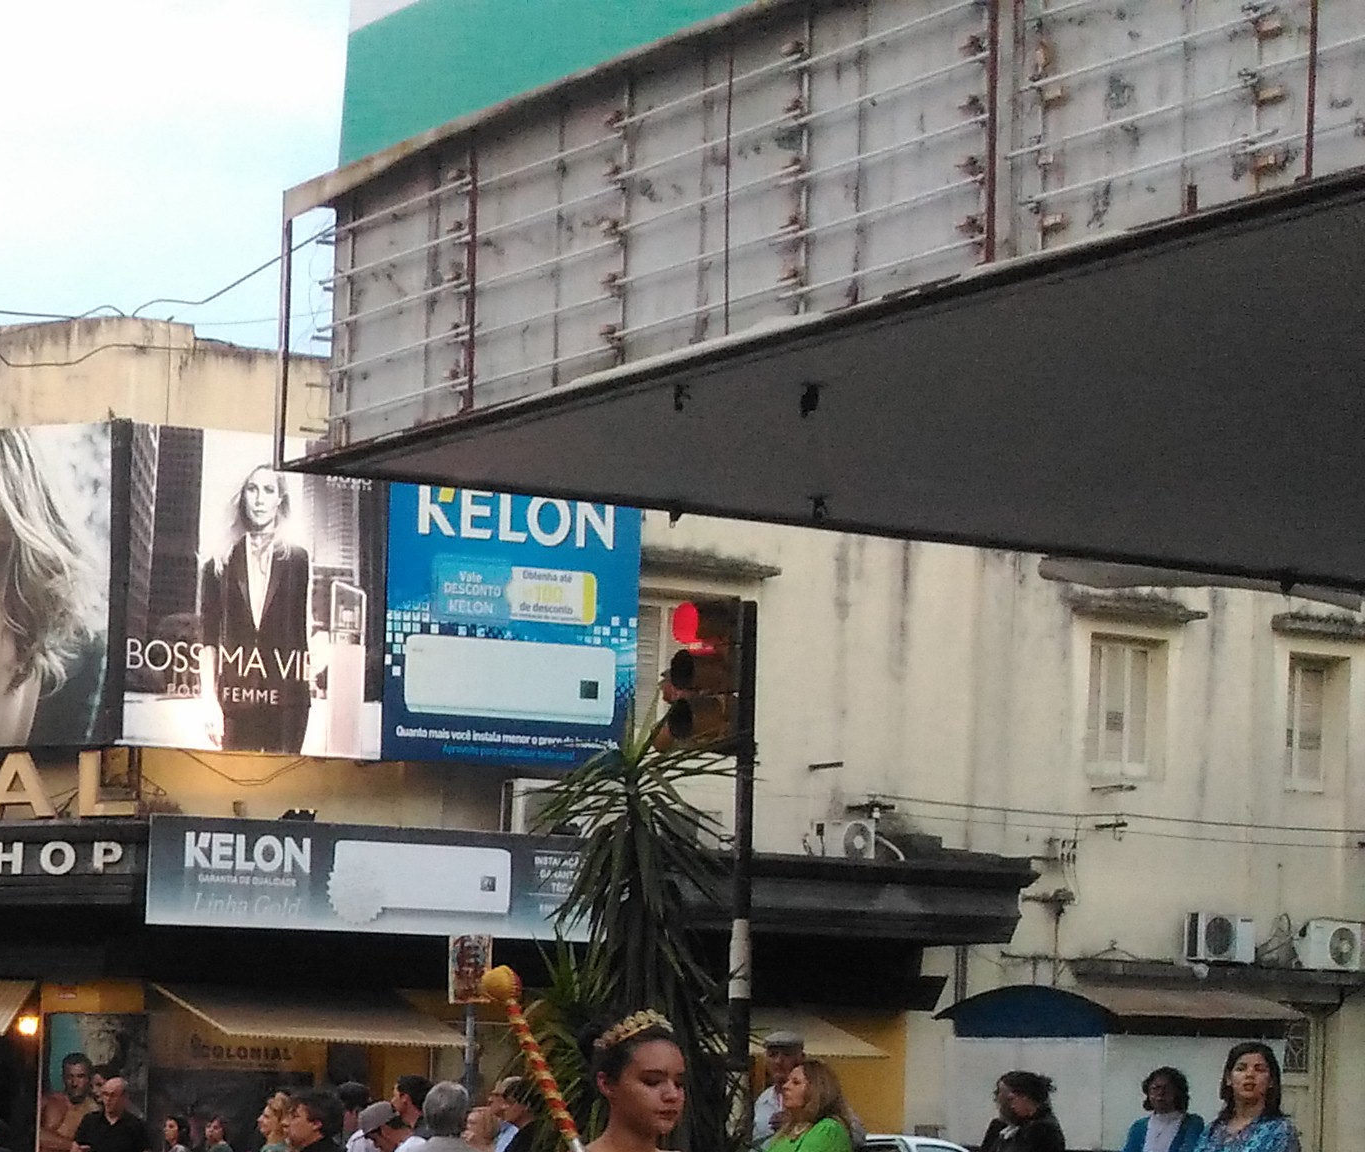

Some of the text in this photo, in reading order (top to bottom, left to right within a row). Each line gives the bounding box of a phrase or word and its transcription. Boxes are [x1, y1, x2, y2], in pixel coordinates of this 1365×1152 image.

[417, 484, 615, 549] KELON
[459, 571, 483, 584] Vale
[443, 582, 502, 598] DESCONTO
[448, 599, 495, 613] KELON
[533, 603, 574, 615] desconto
[125, 637, 207, 674] BOSS
[218, 645, 267, 679] MA
[222, 686, 280, 705] FEMME
[395, 725, 427, 738] Quanto
[429, 727, 450, 740] mais
[184, 831, 312, 873] KELON
[534, 856, 579, 869] INSTALAÇ
[198, 873, 297, 887] GARANTIA DE QUALIDADE
[194, 893, 301, 917] Linha Gold
